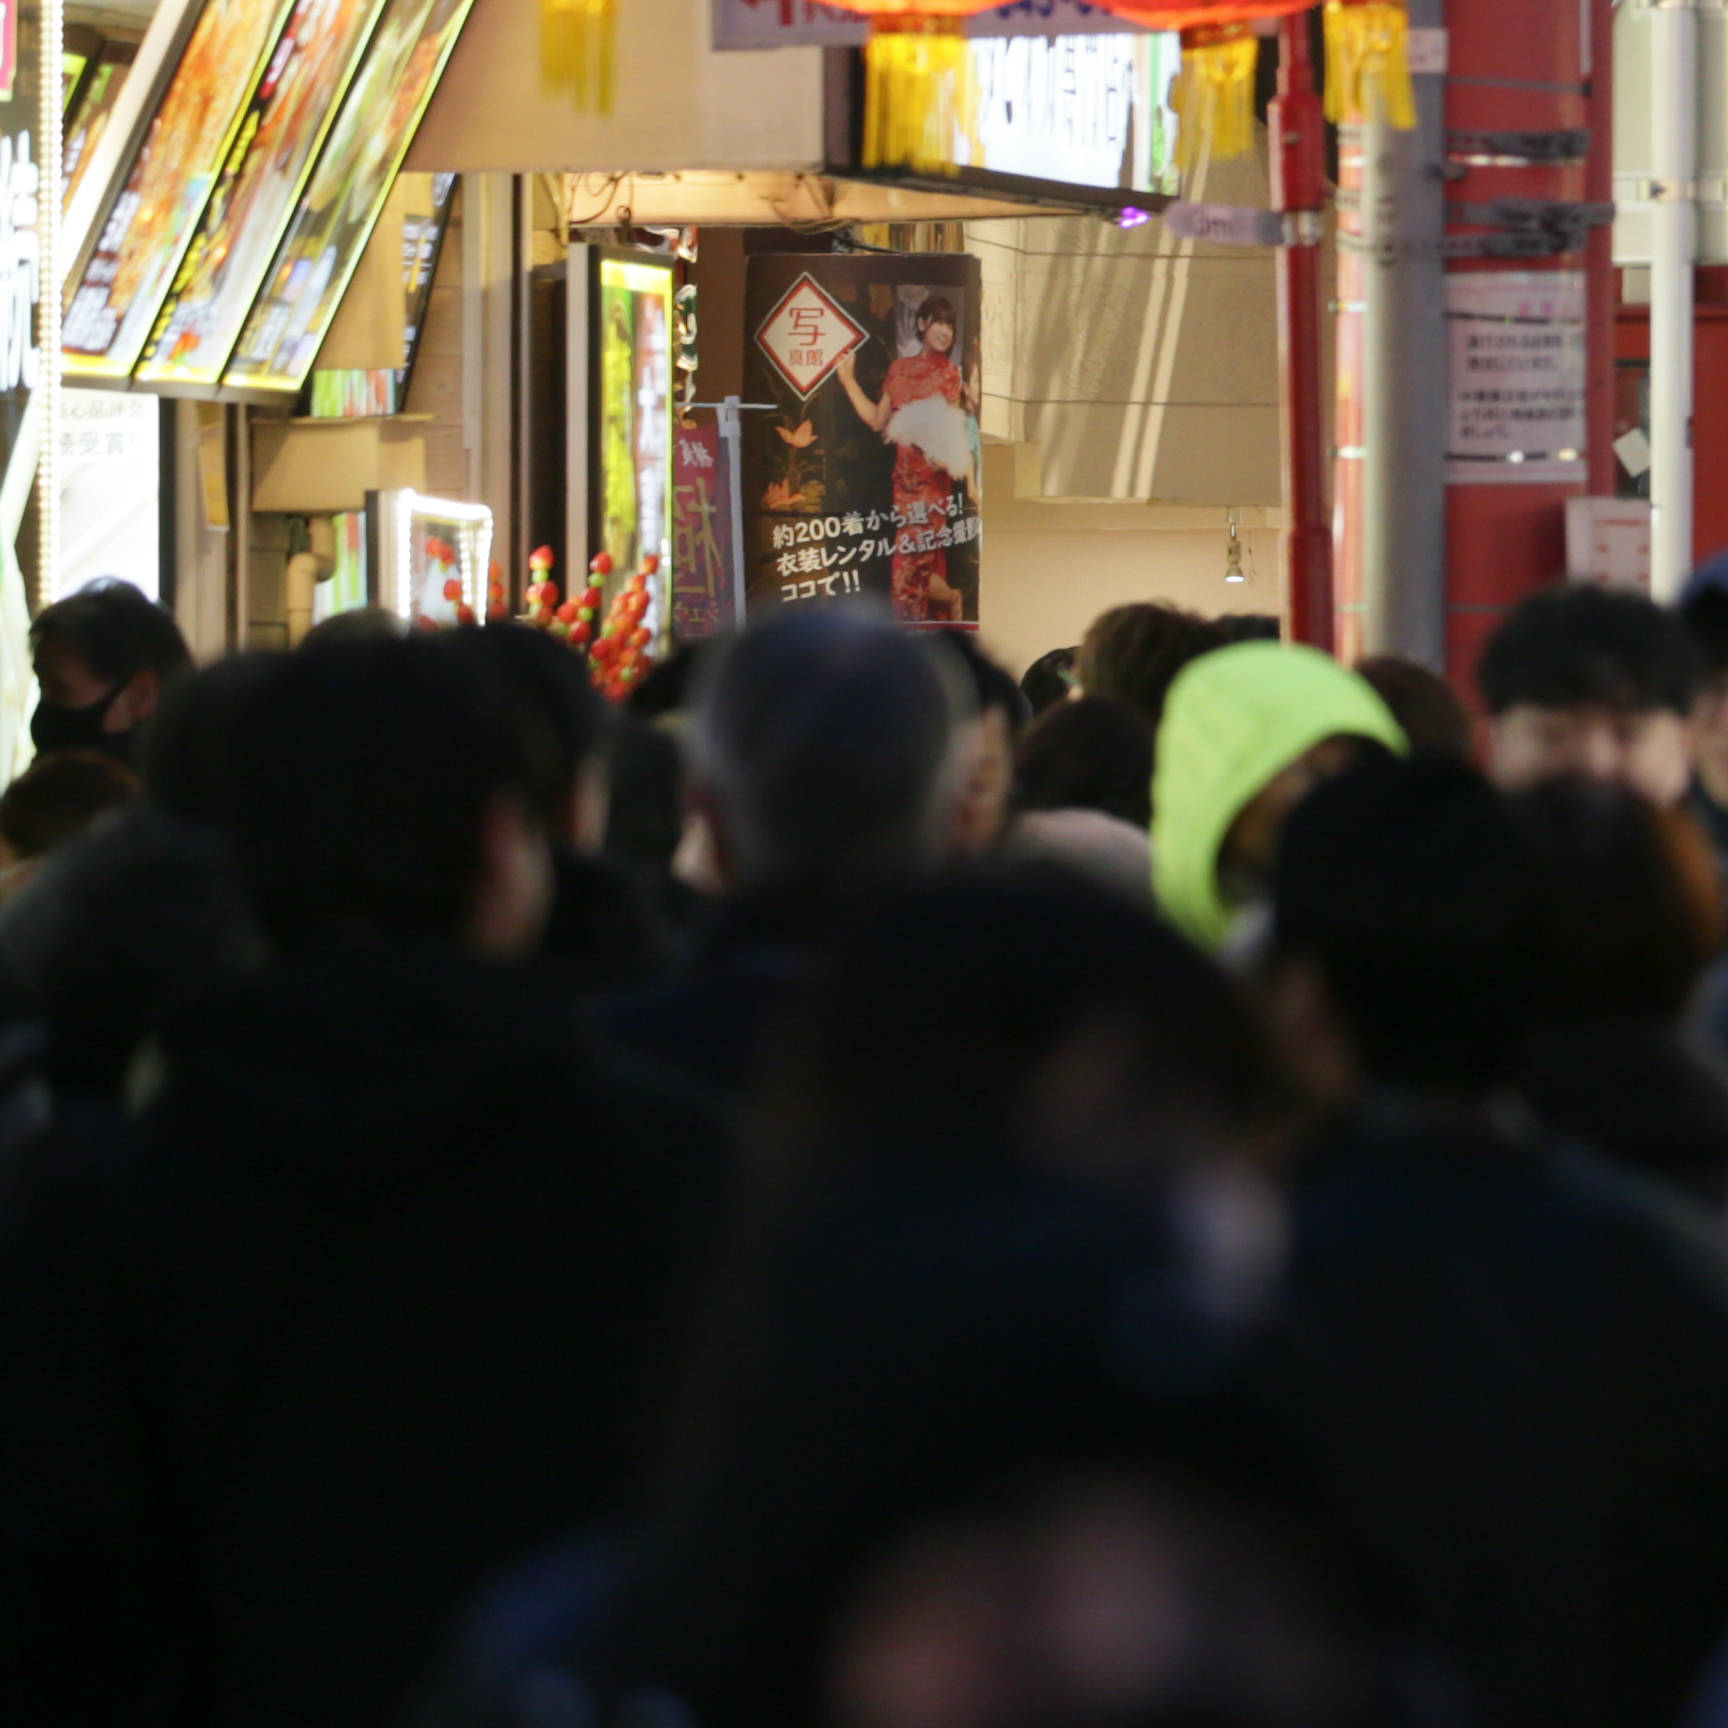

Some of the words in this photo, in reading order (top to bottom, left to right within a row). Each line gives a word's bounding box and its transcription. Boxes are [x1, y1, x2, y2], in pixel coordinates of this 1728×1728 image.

[787, 307, 827, 347] 写
[772, 492, 964, 550] 約200着から選べる!
[780, 568, 862, 604] ココで!!
